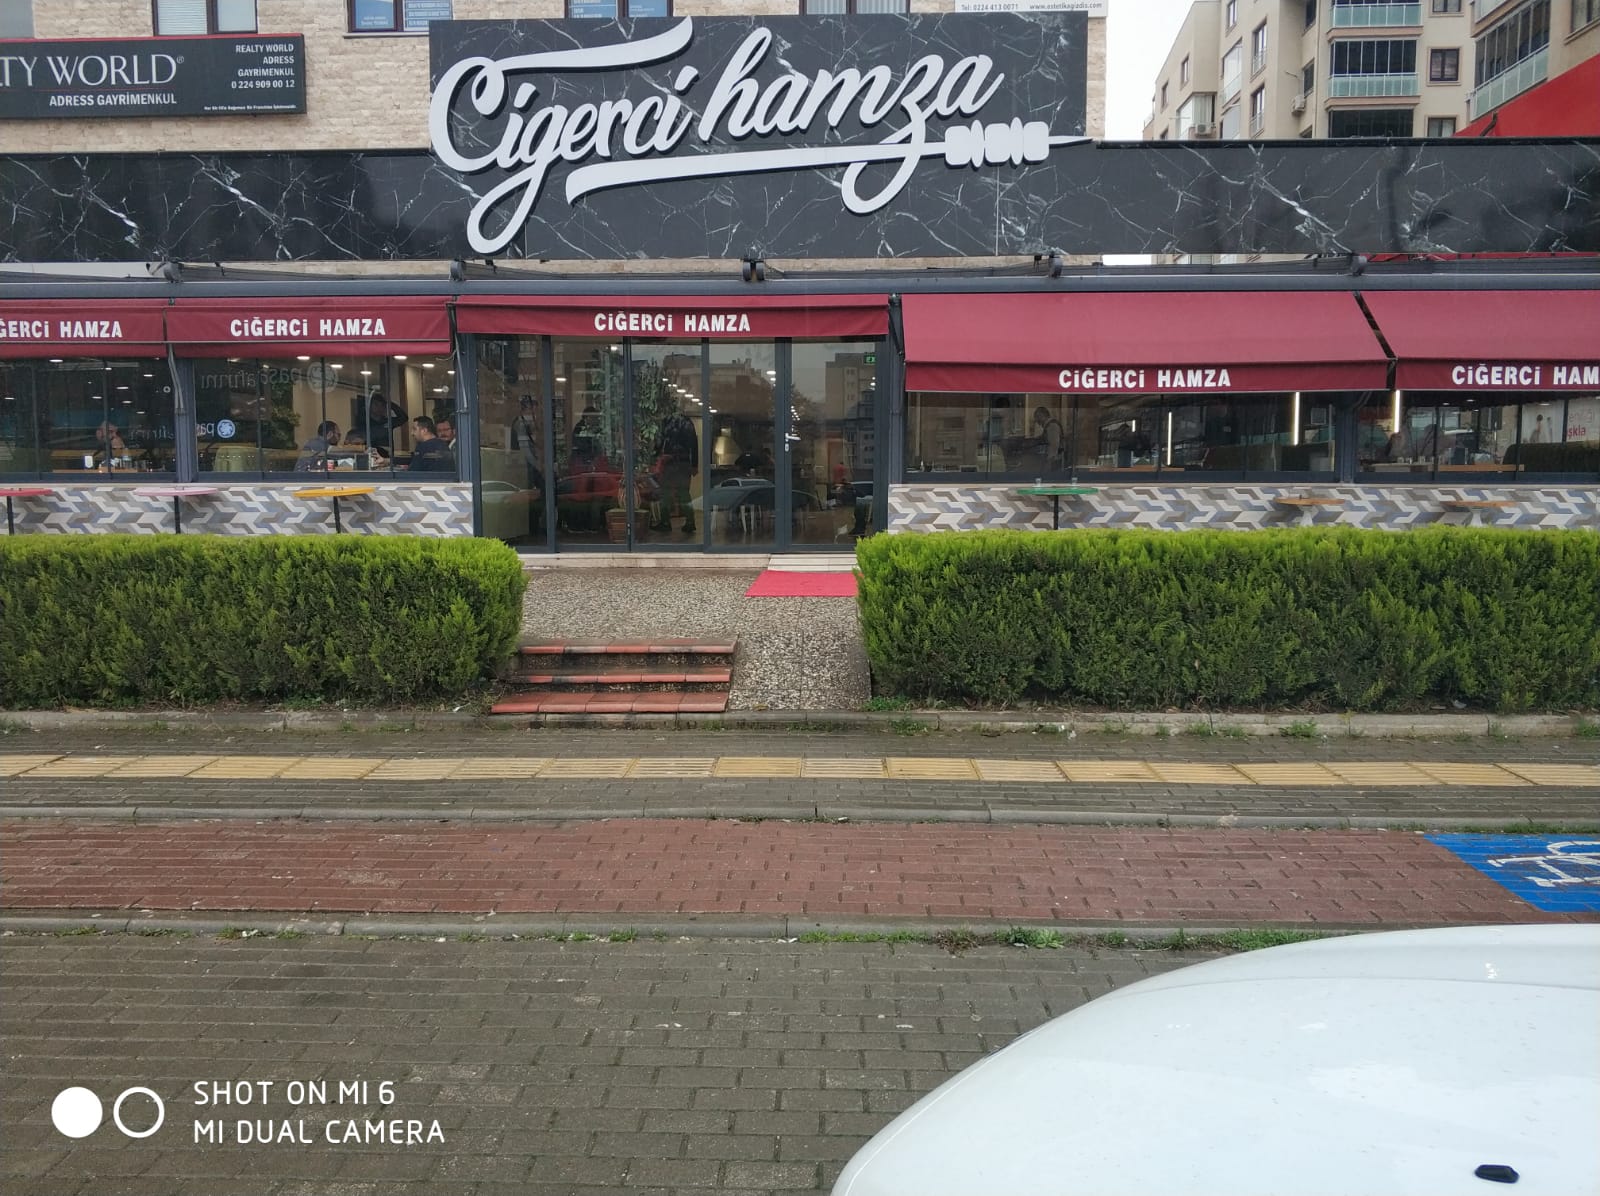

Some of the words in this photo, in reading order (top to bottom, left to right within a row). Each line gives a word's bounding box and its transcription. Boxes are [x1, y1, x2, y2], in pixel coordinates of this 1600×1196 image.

[235, 44, 264, 53] REALTY
[265, 43, 294, 53] WORLD
[262, 55, 295, 65] ADRESS
[0, 56, 38, 87] TY
[237, 66, 295, 77] GAYRİMENKUL
[231, 80, 237, 89] 0
[238, 80, 254, 89] 224
[255, 79, 271, 89] 909
[272, 79, 283, 88] 00
[285, 79, 295, 88] 12
[49, 94, 95, 107] ADRESS
[97, 91, 177, 106] GAYRİMENKUL
[60, 320, 123, 338] HAMZA
[319, 318, 386, 336] HAMZA
[684, 313, 751, 332] HAMZA
[1157, 368, 1232, 388] HAMZA
[1552, 366, 1600, 385] HAM
